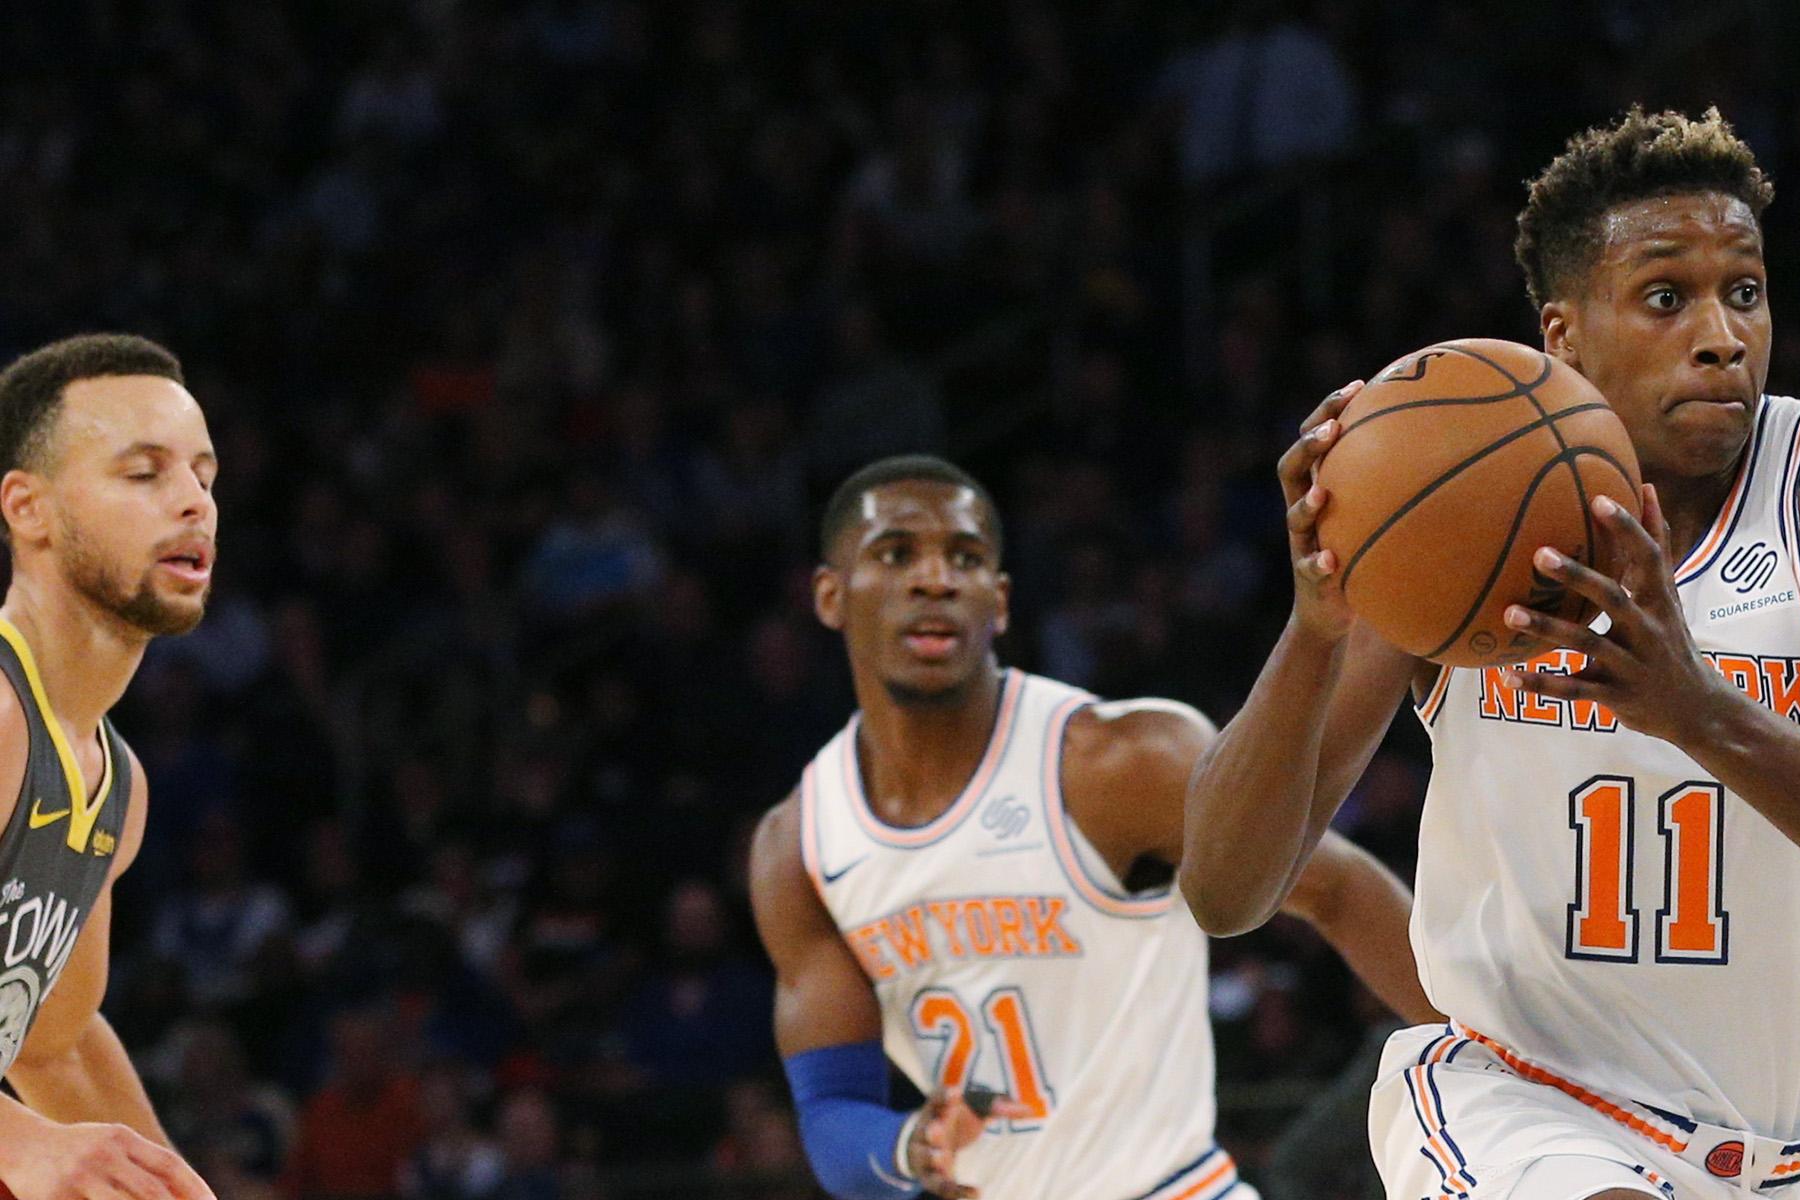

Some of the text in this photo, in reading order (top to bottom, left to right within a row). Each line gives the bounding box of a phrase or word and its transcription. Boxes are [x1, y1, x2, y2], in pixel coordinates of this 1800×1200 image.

[1709, 590, 1795, 620] SQUARESPACE
[1565, 775, 1729, 965] 11
[926, 896, 1084, 961] YORK
[909, 985, 1056, 1134] 21
